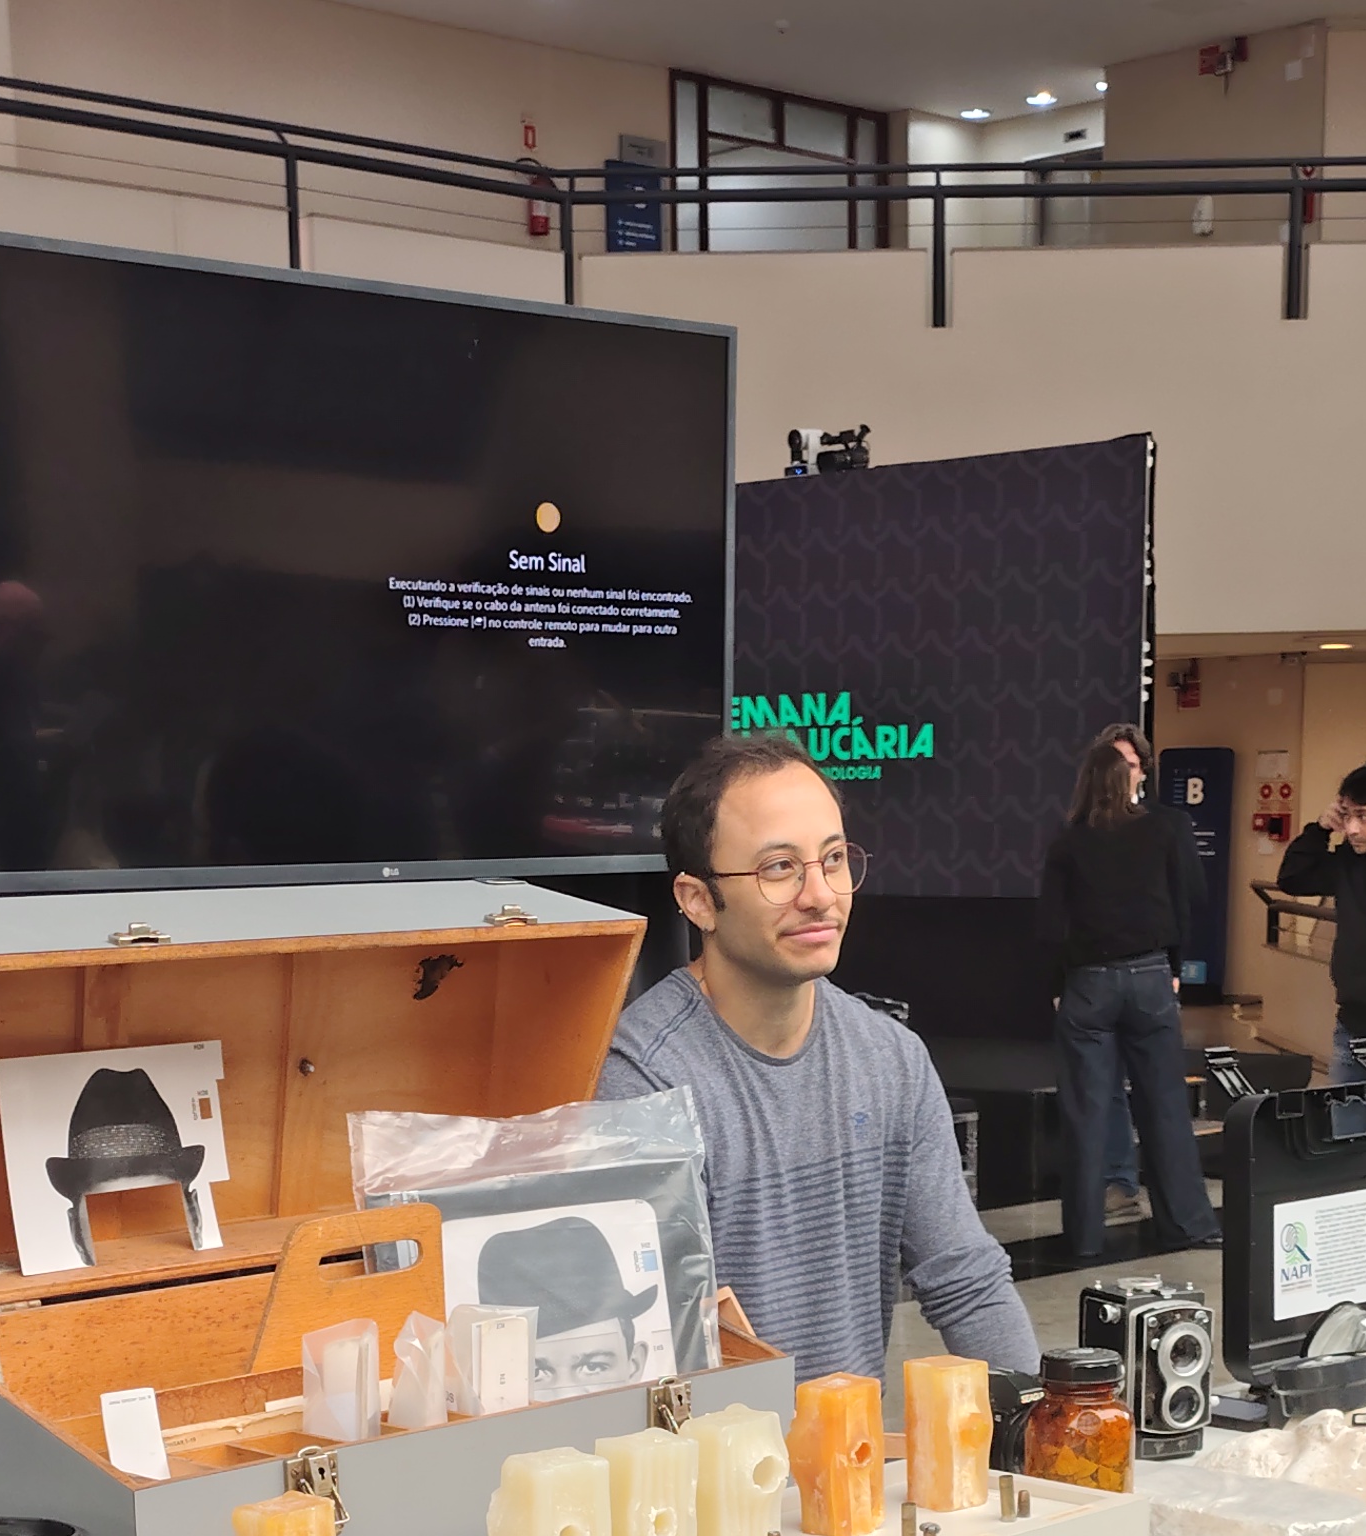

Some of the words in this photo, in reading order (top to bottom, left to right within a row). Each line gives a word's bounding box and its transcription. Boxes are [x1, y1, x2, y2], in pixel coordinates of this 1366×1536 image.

[508, 549, 544, 571] Sem
[548, 551, 586, 574] Sinal
[388, 577, 447, 592] Executando
[448, 583, 456, 593] a
[457, 581, 509, 597] verificação
[511, 584, 524, 596] de
[525, 584, 550, 597] sinais
[552, 587, 565, 598] ou
[566, 587, 604, 600] nenhum
[605, 588, 626, 601] sinal
[627, 589, 640, 601] foi
[641, 591, 693, 603] encontrado.
[402, 595, 415, 609] (1)
[416, 596, 461, 611] Verifique
[462, 599, 474, 610] se
[475, 600, 482, 611] o
[484, 600, 508, 612] cabo
[509, 600, 522, 612] da
[523, 602, 556, 614] antena
[557, 602, 570, 614] foi
[571, 604, 619, 617] conectado
[621, 606, 681, 620] corretamente.
[407, 613, 421, 627] (2)
[422, 614, 469, 628] Pressione
[488, 618, 501, 629] no
[503, 618, 543, 630] controle
[544, 620, 578, 632] remoto
[579, 623, 600, 634] para
[601, 622, 630, 633] mudar
[632, 624, 652, 636] para
[653, 624, 678, 635] outra
[528, 636, 567, 648] entrada.
[731, 691, 851, 729] EMANA
[741, 716, 934, 761] UCÁRIA
[1186, 777, 1204, 805] B
[1280, 1263, 1312, 1283] NAPI
